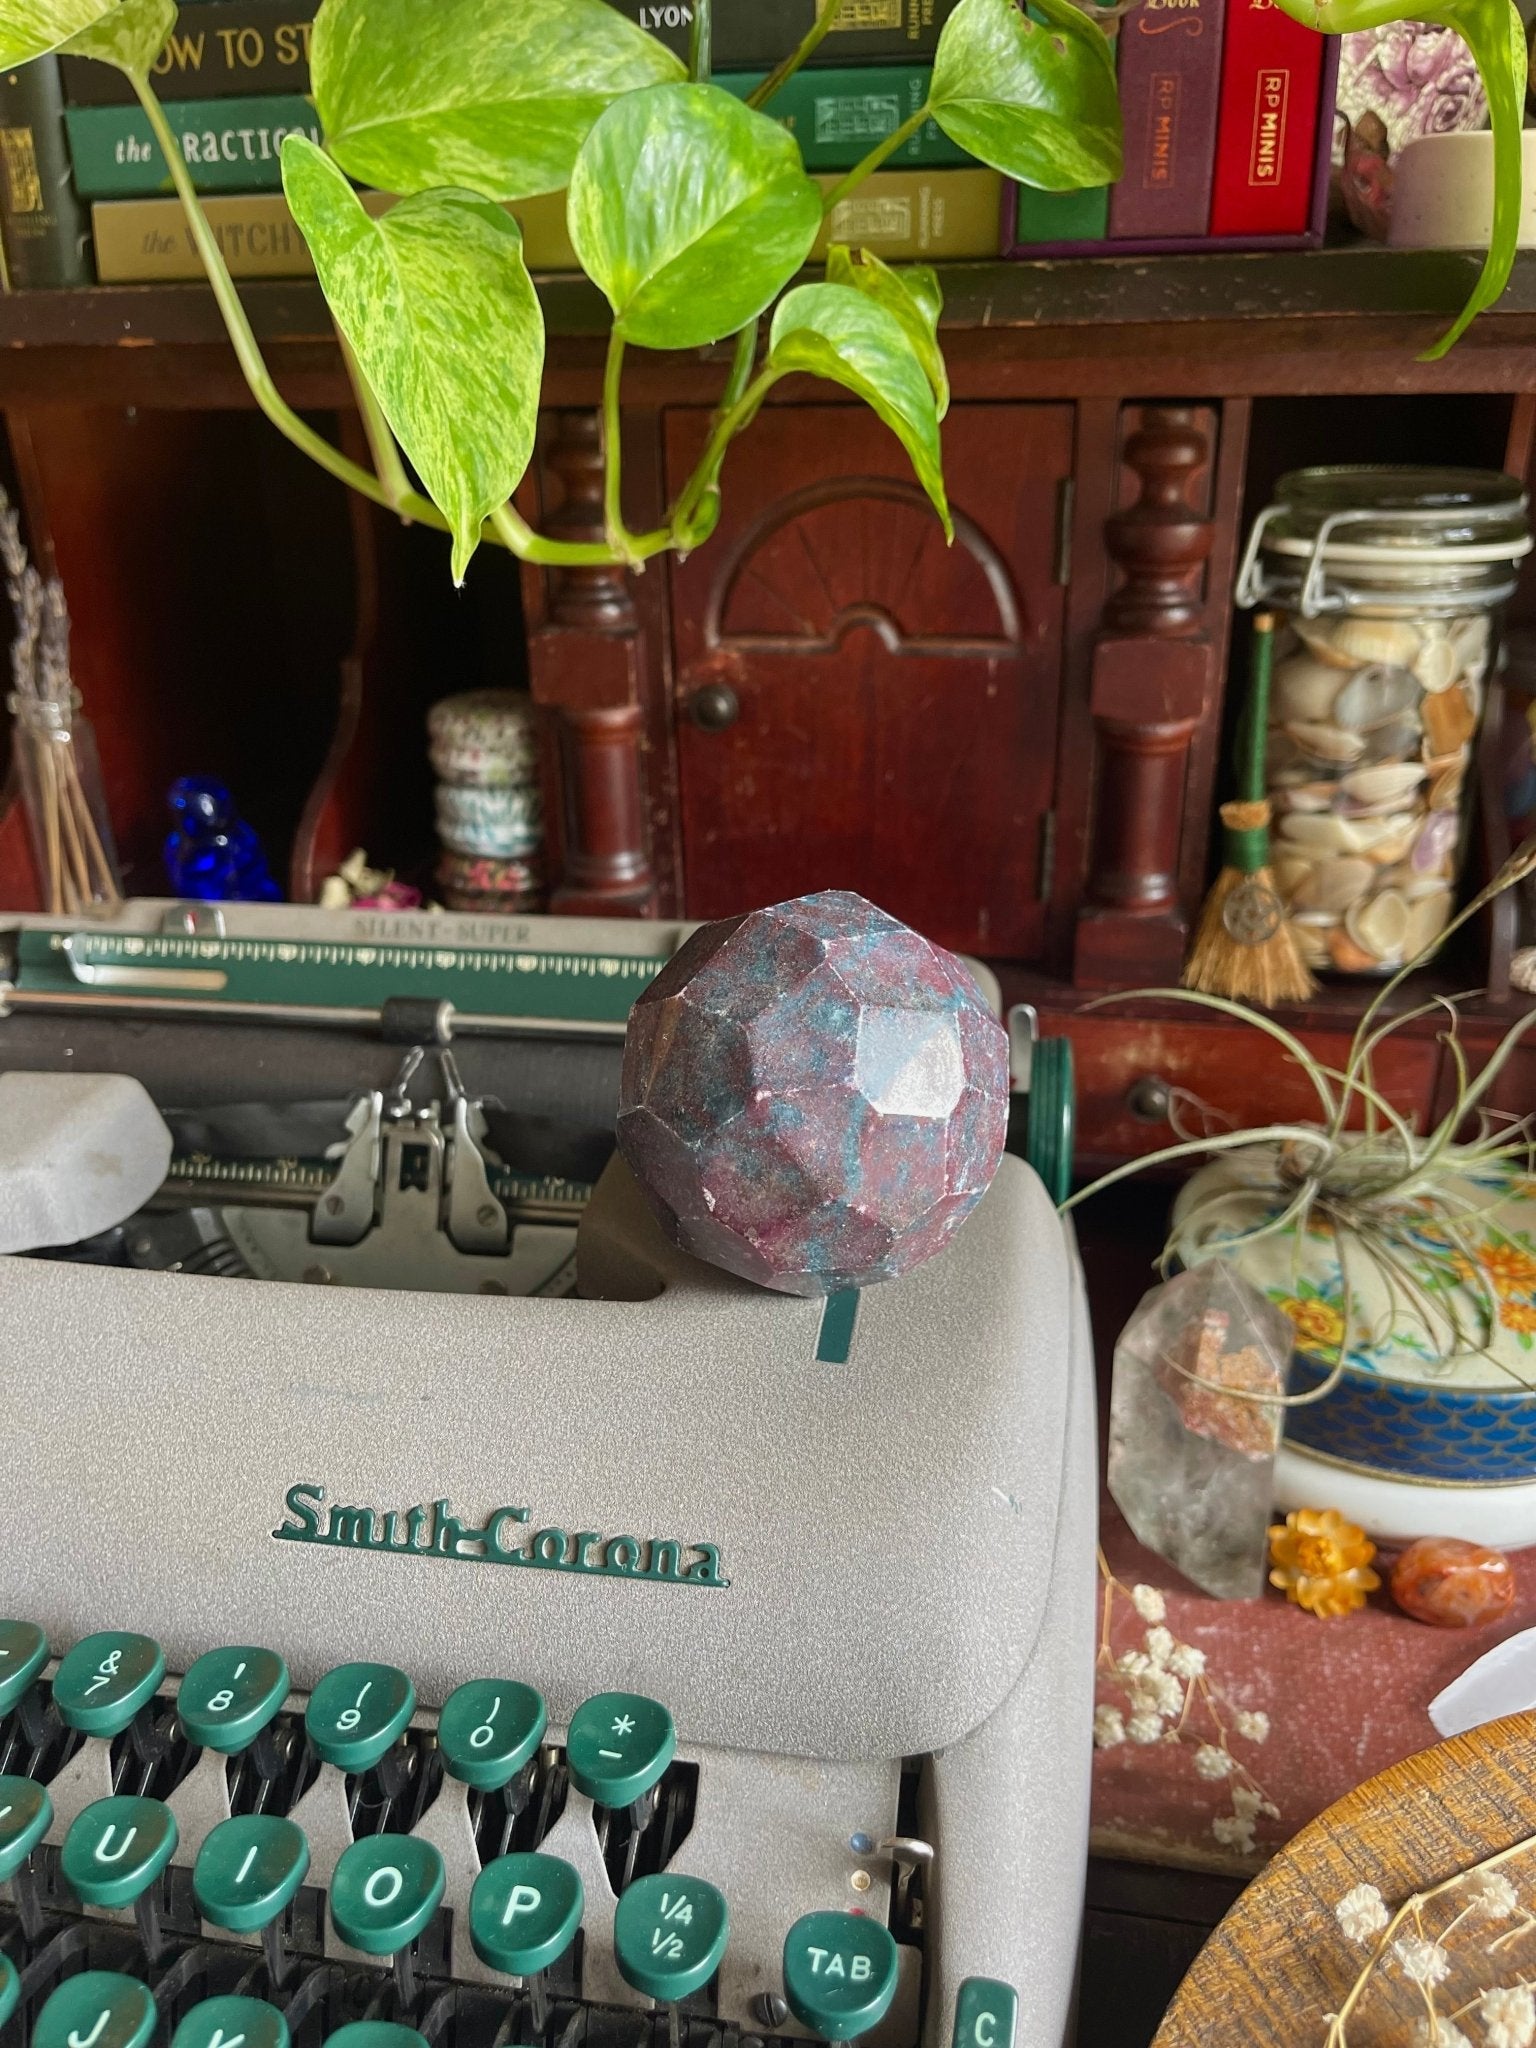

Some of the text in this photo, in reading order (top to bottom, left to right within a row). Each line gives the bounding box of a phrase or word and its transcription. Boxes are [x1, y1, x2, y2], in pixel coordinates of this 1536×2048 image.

[152, 23, 314, 75] OW TO ST
[1256, 77, 1282, 178] RP MINIS
[115, 134, 151, 164] the
[1151, 116, 1171, 180] MINIS
[271, 1482, 732, 1588] Smith-Corona
[83, 1674, 110, 1696] 7
[207, 1689, 234, 1711] 8
[336, 1708, 361, 1730] 9
[95, 1824, 137, 1862] U
[235, 1845, 258, 1883] I
[364, 1865, 403, 1906] O
[502, 1884, 541, 1925] P
[651, 1927, 684, 1959] 1/2
[807, 1946, 871, 1980] TAB
[974, 2011, 996, 2047] C
